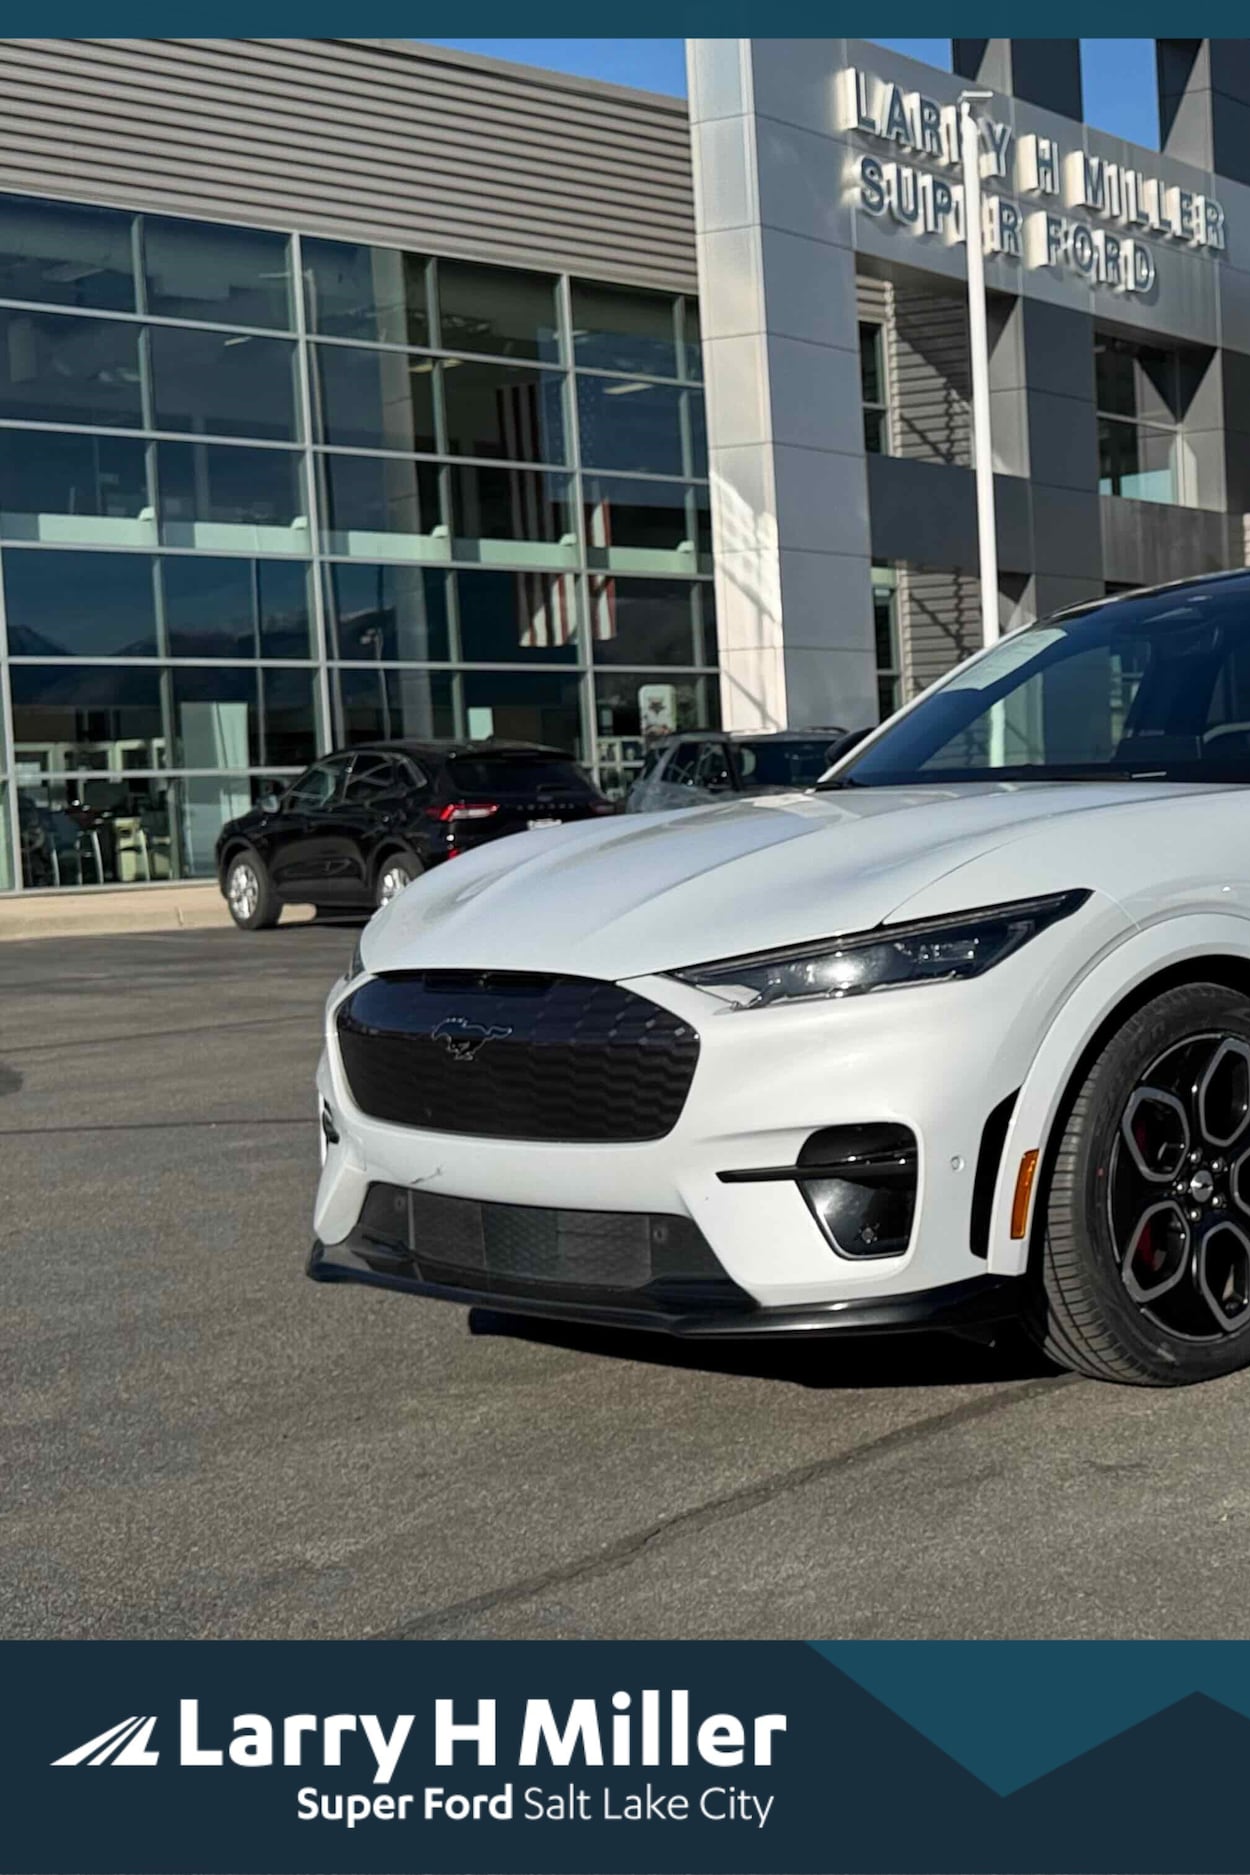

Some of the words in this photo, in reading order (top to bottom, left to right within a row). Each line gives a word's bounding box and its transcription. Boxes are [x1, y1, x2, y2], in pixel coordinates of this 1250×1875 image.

[860, 154, 1024, 257] SUPR
[1032, 201, 1157, 293] FORD
[1024, 134, 1060, 195] H
[1067, 150, 1225, 250] MILLER
